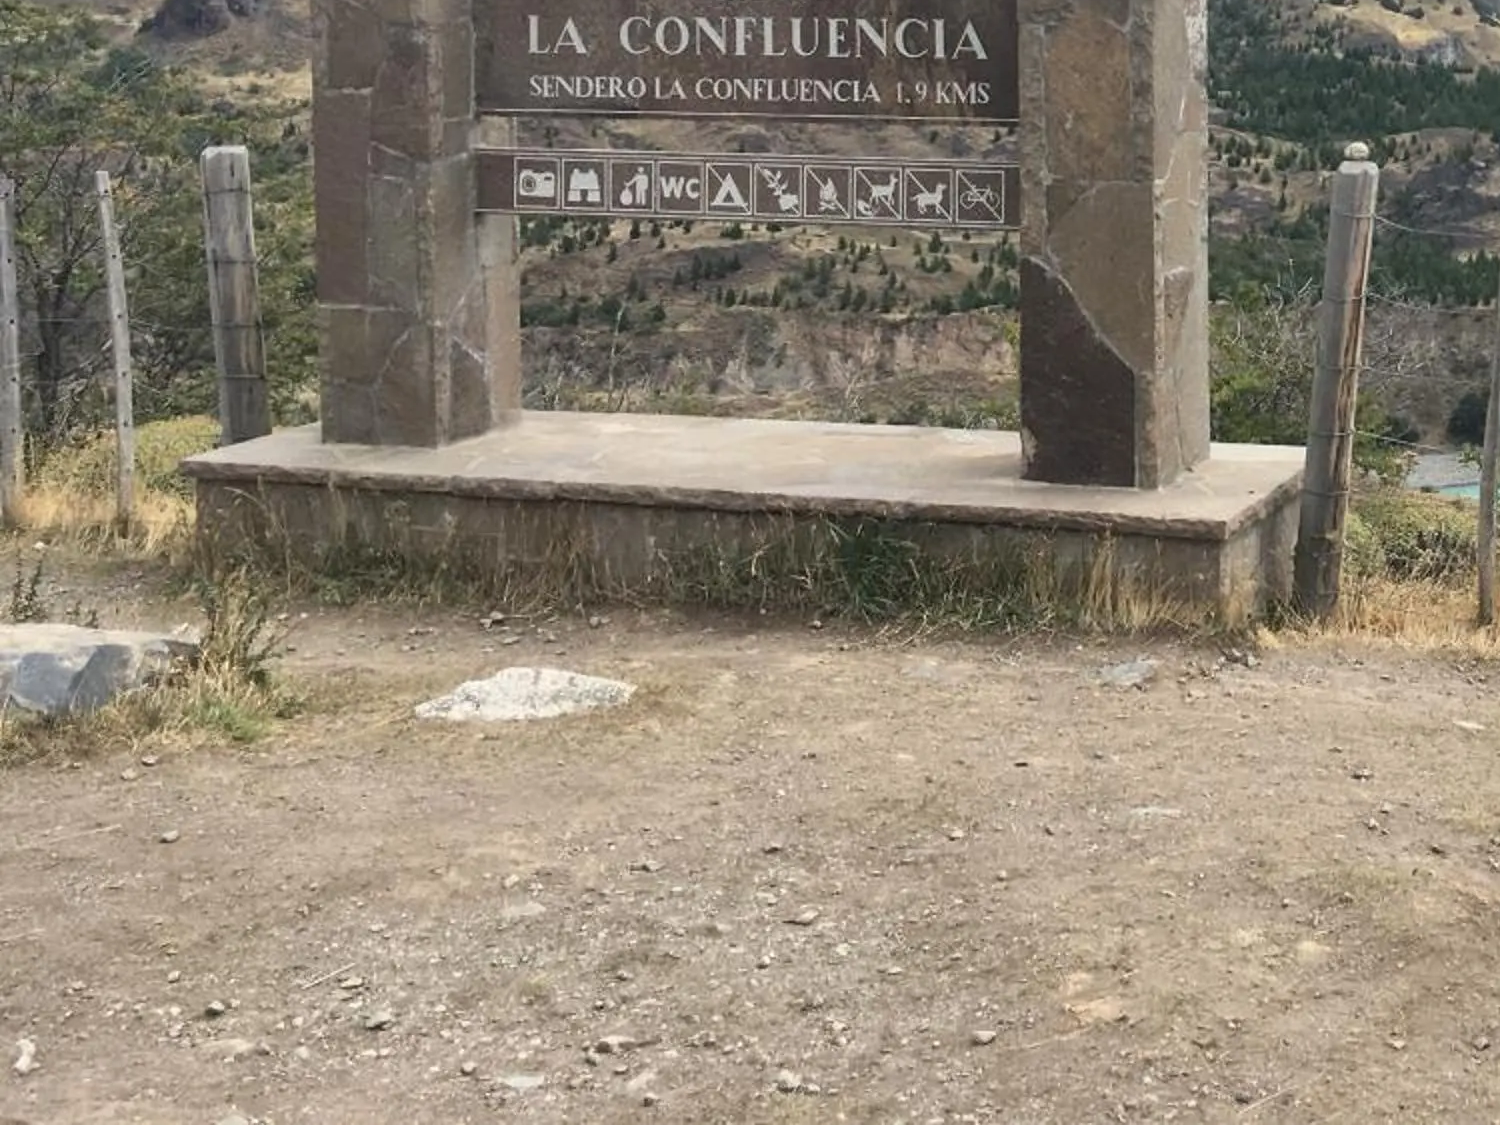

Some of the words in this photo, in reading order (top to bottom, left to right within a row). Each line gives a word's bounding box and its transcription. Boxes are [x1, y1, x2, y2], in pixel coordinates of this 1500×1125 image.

[528, 14, 588, 56] LA
[619, 15, 989, 61] CONFLUENCIA
[529, 75, 647, 100] SENDERO
[655, 78, 688, 101] LA
[695, 77, 882, 104] CONFLUENCIA
[935, 81, 992, 106] KMS
[660, 176, 701, 201] WC
